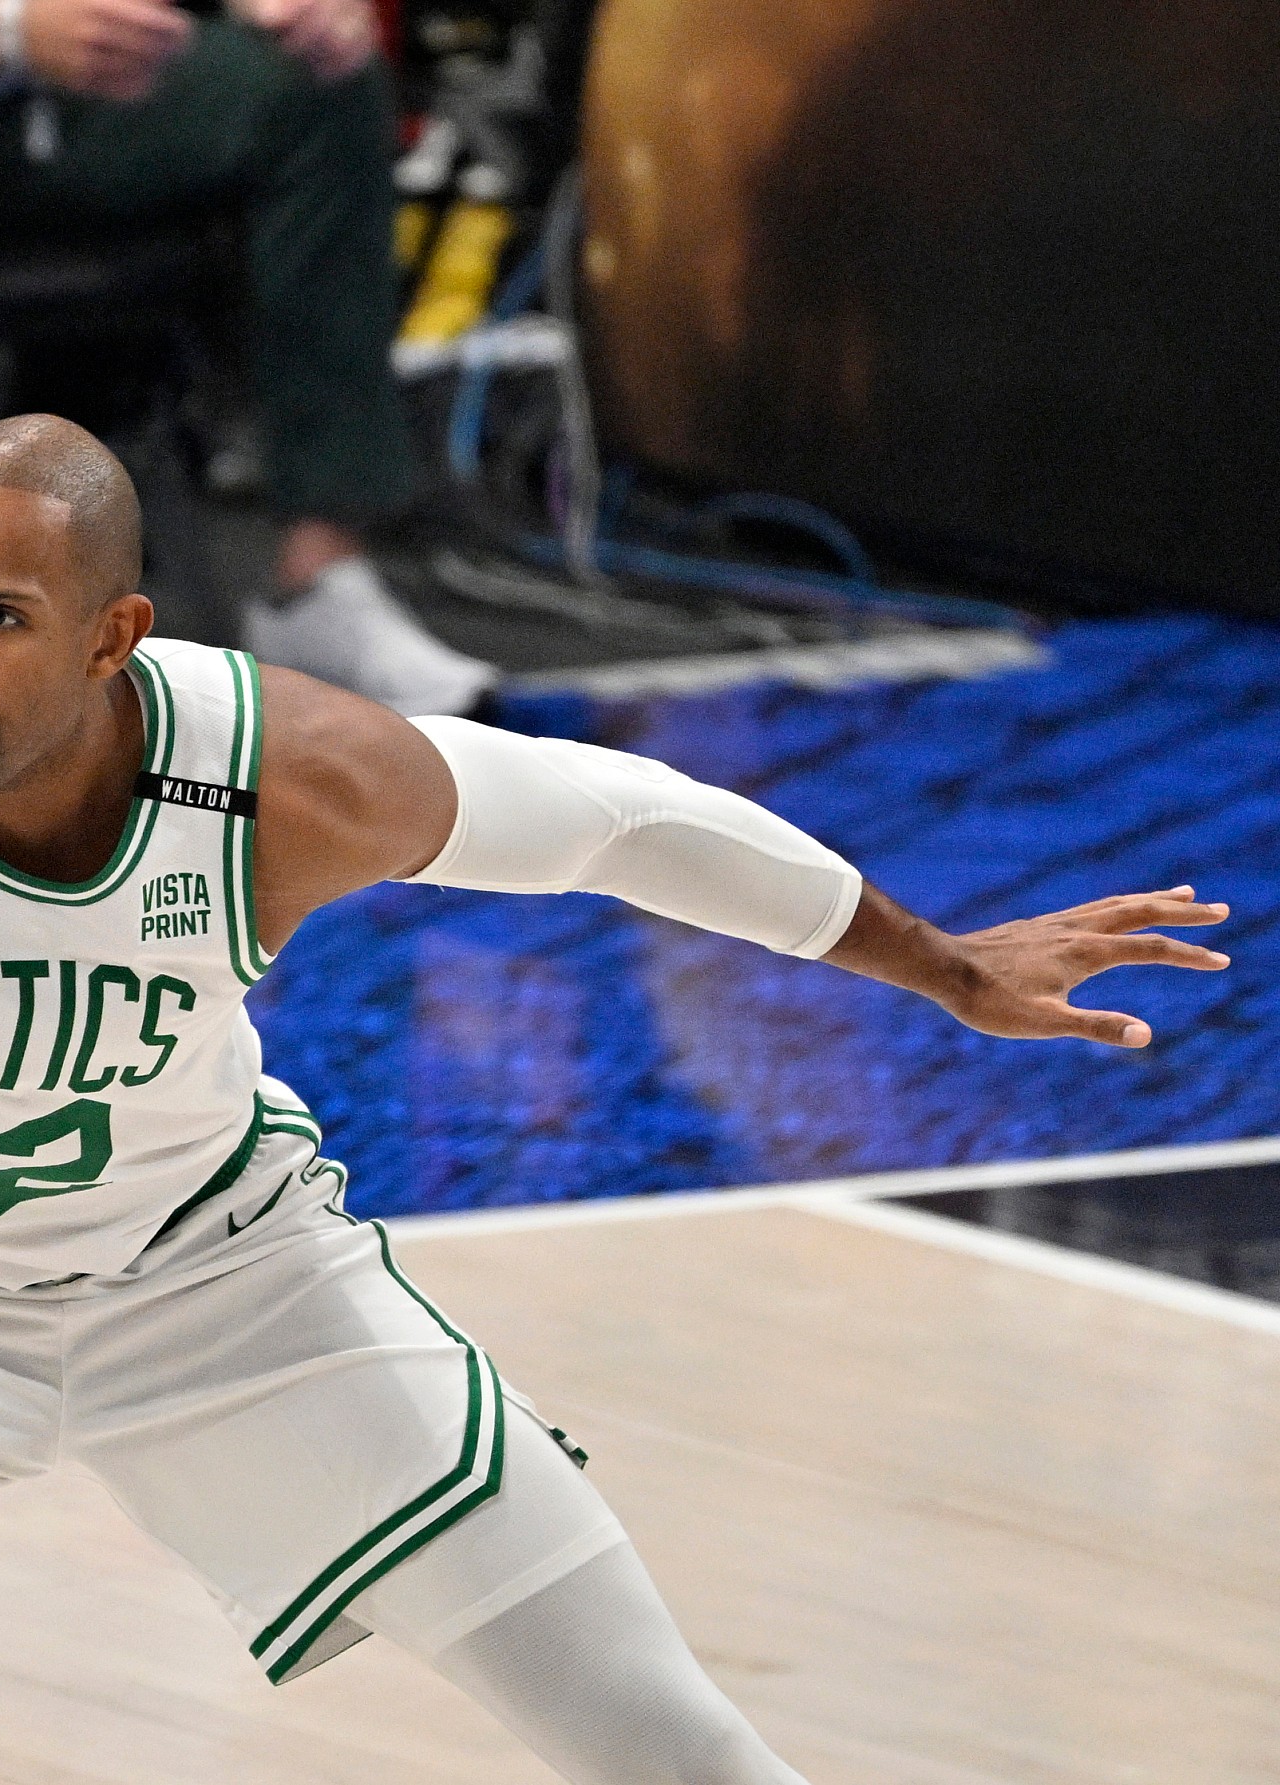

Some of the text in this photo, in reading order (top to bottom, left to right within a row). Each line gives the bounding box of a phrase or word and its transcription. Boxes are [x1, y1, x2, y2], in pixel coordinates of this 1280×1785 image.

[162, 779, 232, 810] WALTON
[142, 872, 211, 914] VISTA
[141, 909, 211, 942] PRINT
